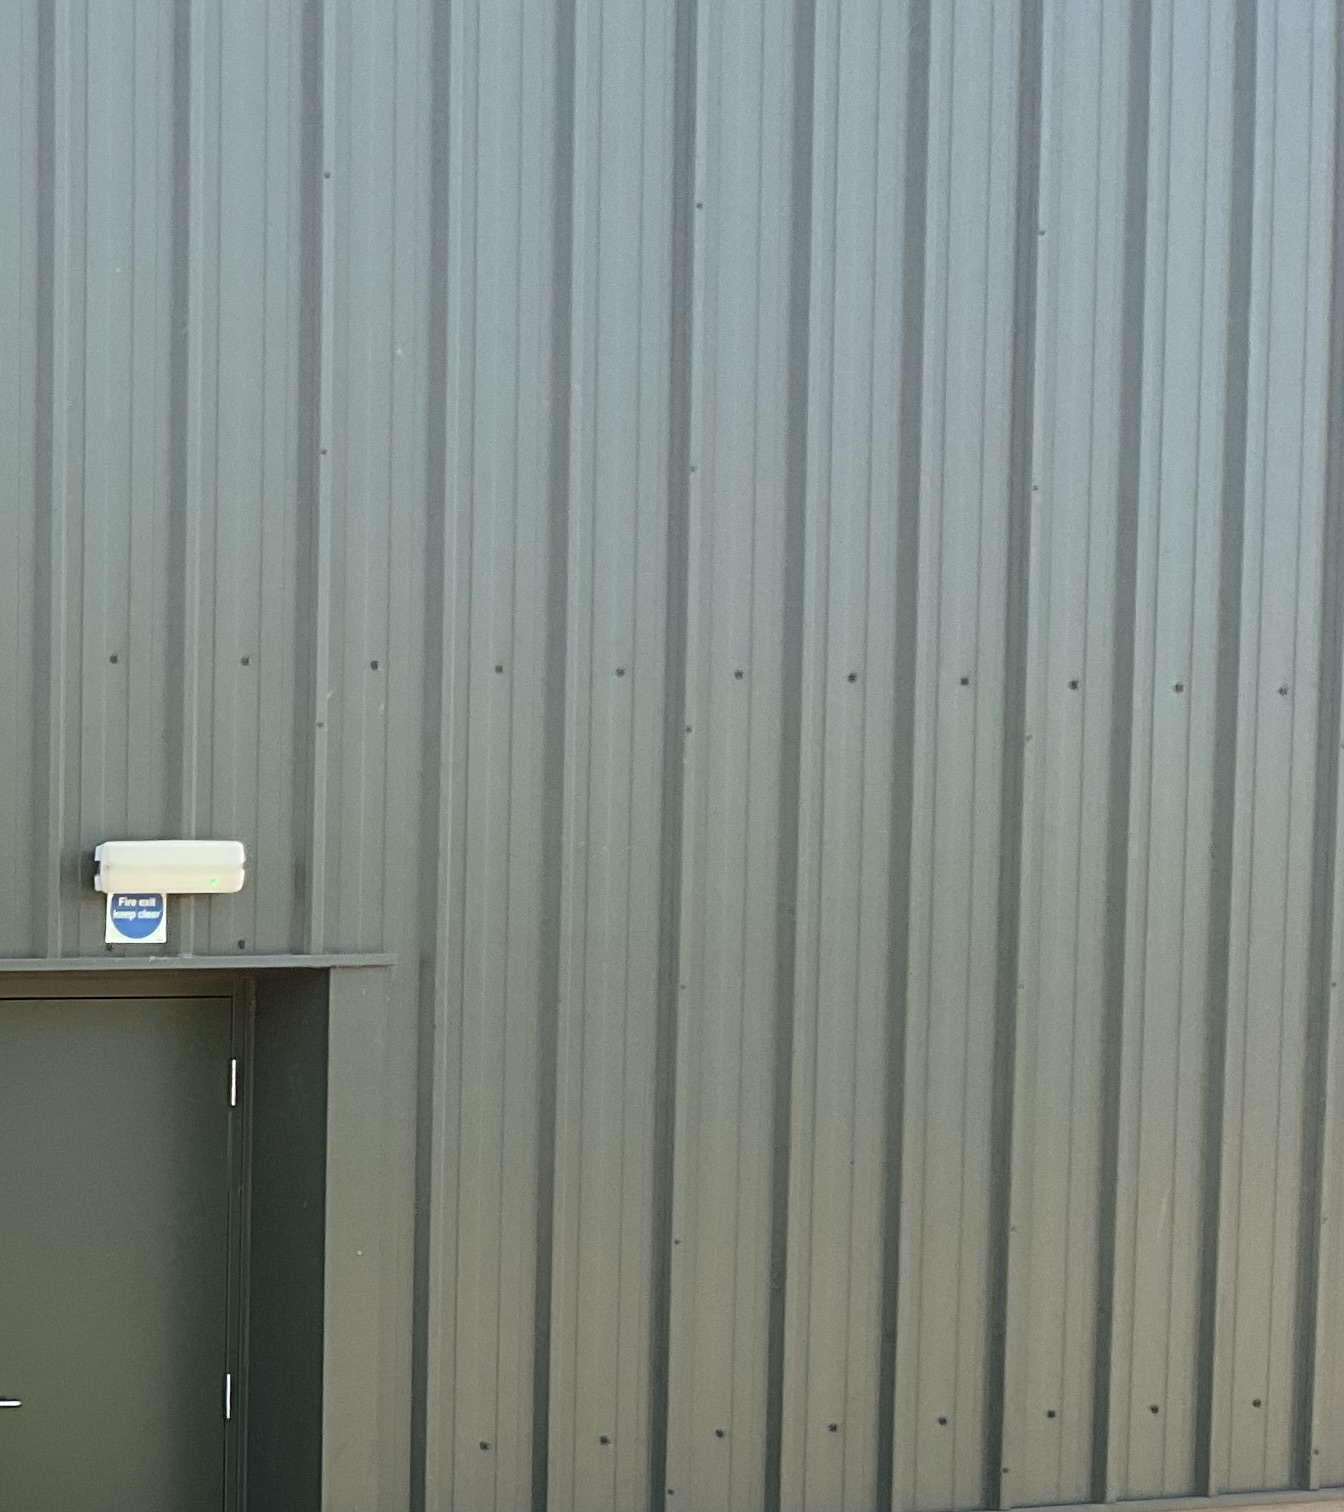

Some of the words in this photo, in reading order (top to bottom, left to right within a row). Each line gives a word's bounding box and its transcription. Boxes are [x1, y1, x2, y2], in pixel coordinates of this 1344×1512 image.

[118, 897, 137, 907] Fire
[139, 897, 156, 907] exit
[113, 909, 136, 921] keep
[138, 909, 162, 919] clear
